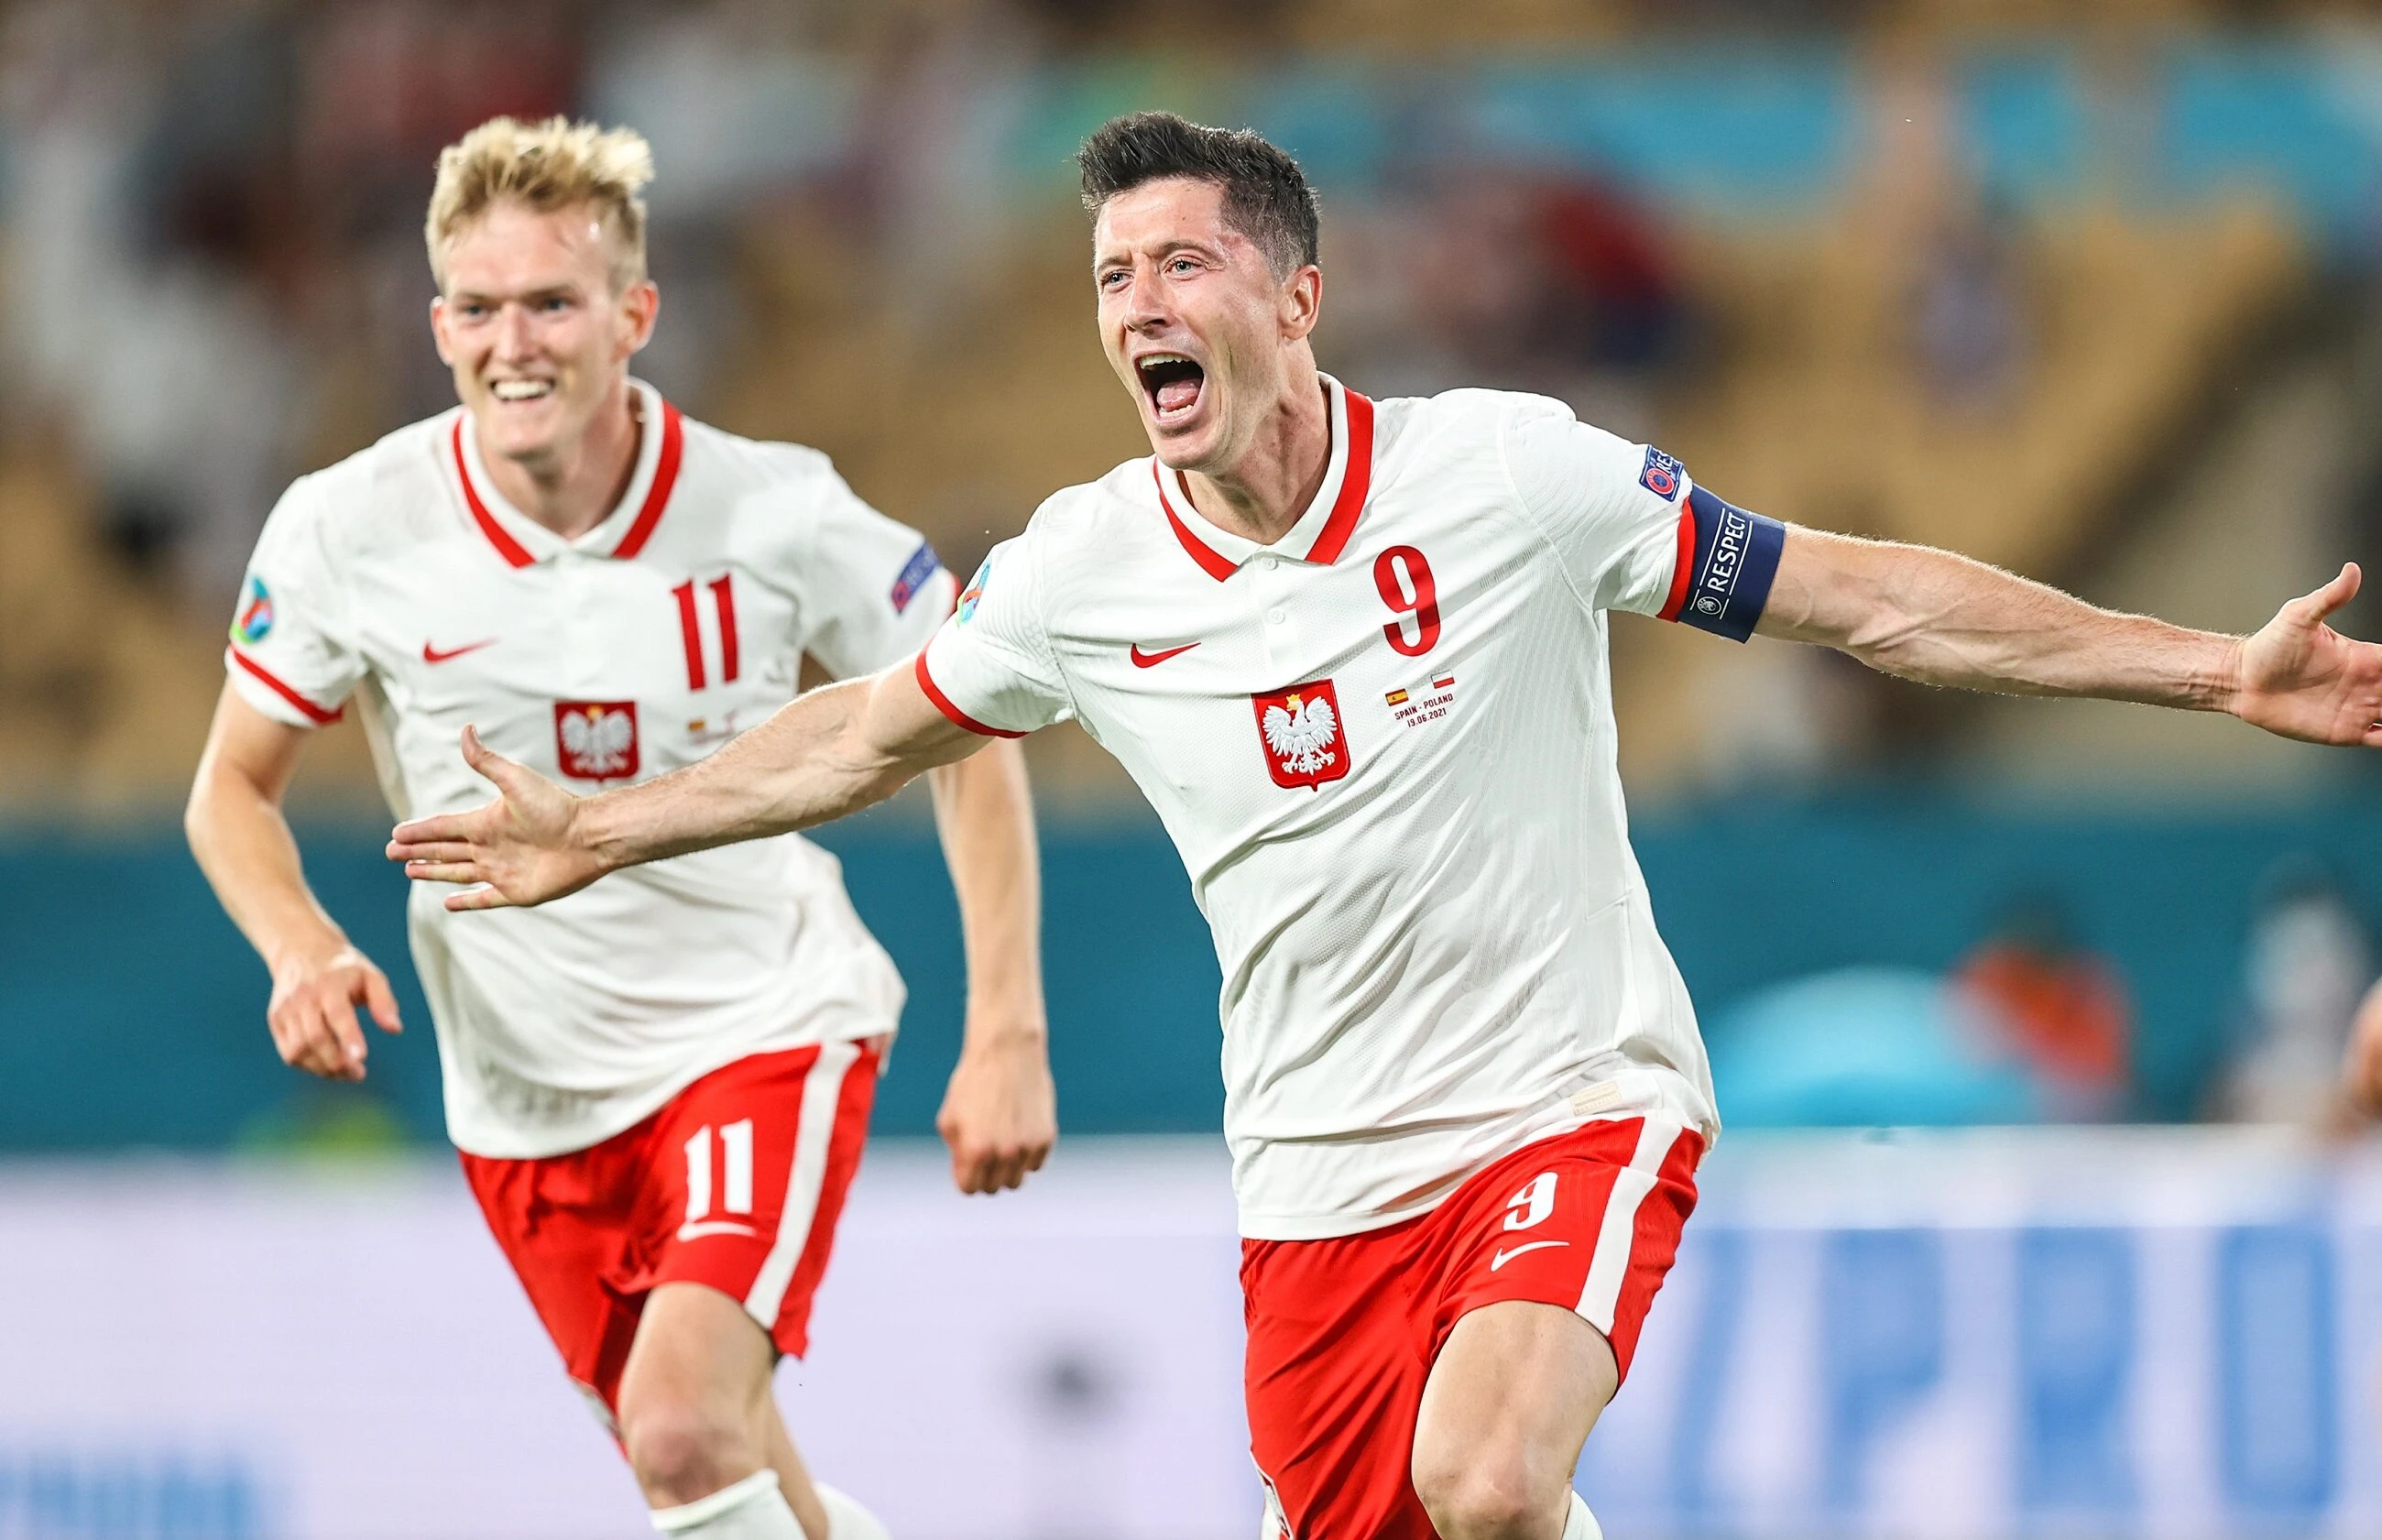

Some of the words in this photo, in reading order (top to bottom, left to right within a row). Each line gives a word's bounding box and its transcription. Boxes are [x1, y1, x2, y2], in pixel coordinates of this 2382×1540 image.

[1707, 511, 1746, 593] RESPECT
[671, 572, 738, 692] 11
[1373, 545, 1441, 657] 9
[1394, 705, 1418, 720] SPAIN
[1424, 694, 1454, 709] POLAND
[1407, 707, 1448, 727] 19.06.2021
[684, 1117, 753, 1222] 11
[1502, 1171, 1558, 1231] 9
